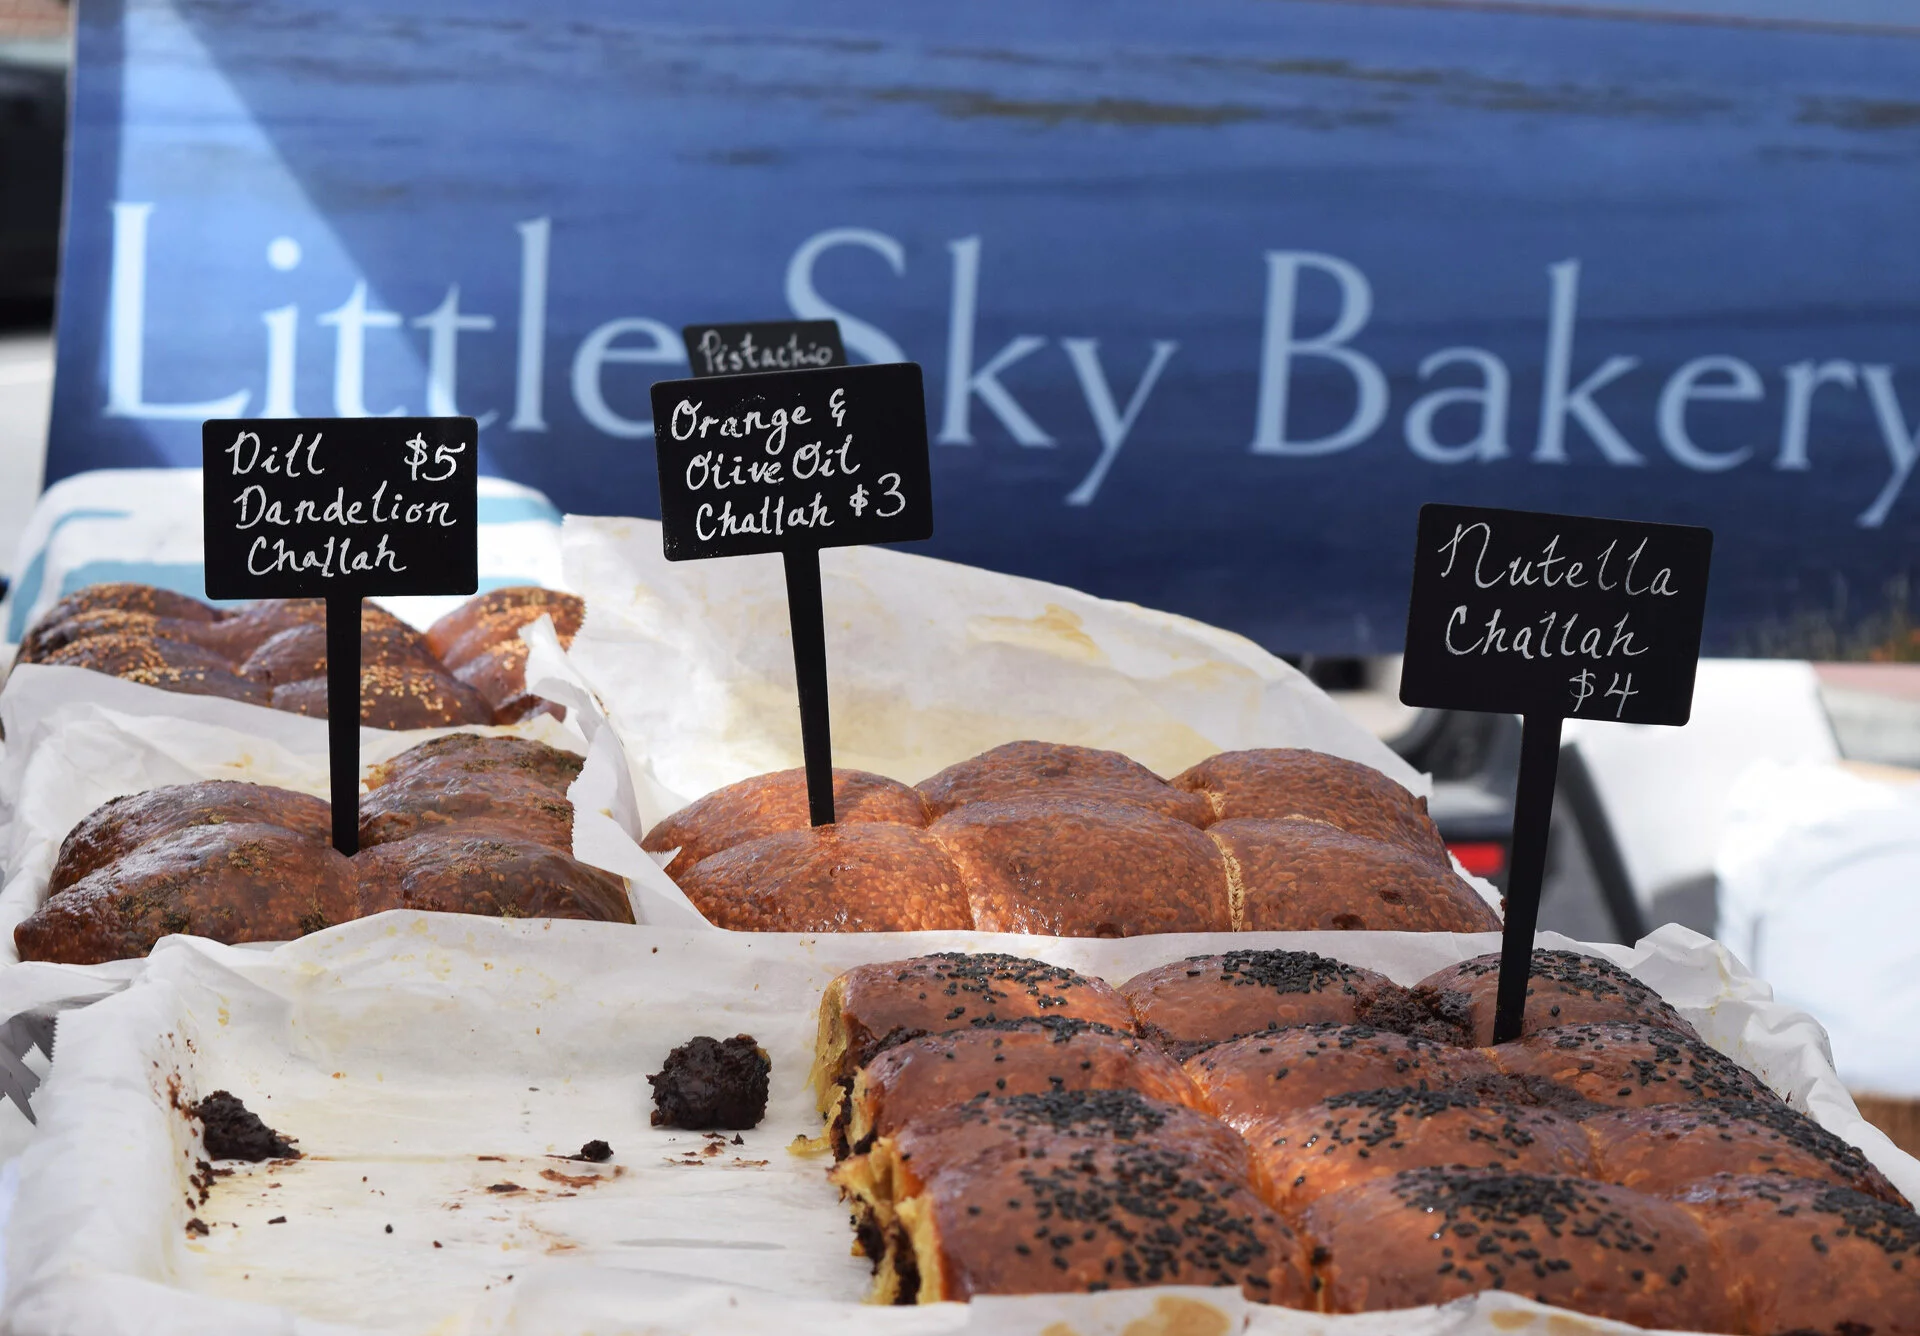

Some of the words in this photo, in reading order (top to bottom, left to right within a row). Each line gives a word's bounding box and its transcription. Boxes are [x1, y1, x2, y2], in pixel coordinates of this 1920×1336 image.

[104, 202, 684, 440] Little
[1250, 249, 1920, 528] Bakery
[698, 329, 833, 373] Pistachio
[225, 430, 325, 476] Dill
[404, 431, 466, 481] $5
[670, 399, 811, 456] Orange
[686, 450, 785, 491] Olive
[792, 433, 861, 480] Oil
[233, 480, 457, 530] Dandelion
[695, 491, 835, 542] Challah
[849, 472, 906, 517] $3
[247, 533, 407, 578] Challah
[1437, 521, 1679, 596] Nutella
[1445, 604, 1649, 660] Challah
[1568, 668, 1639, 719] $4
